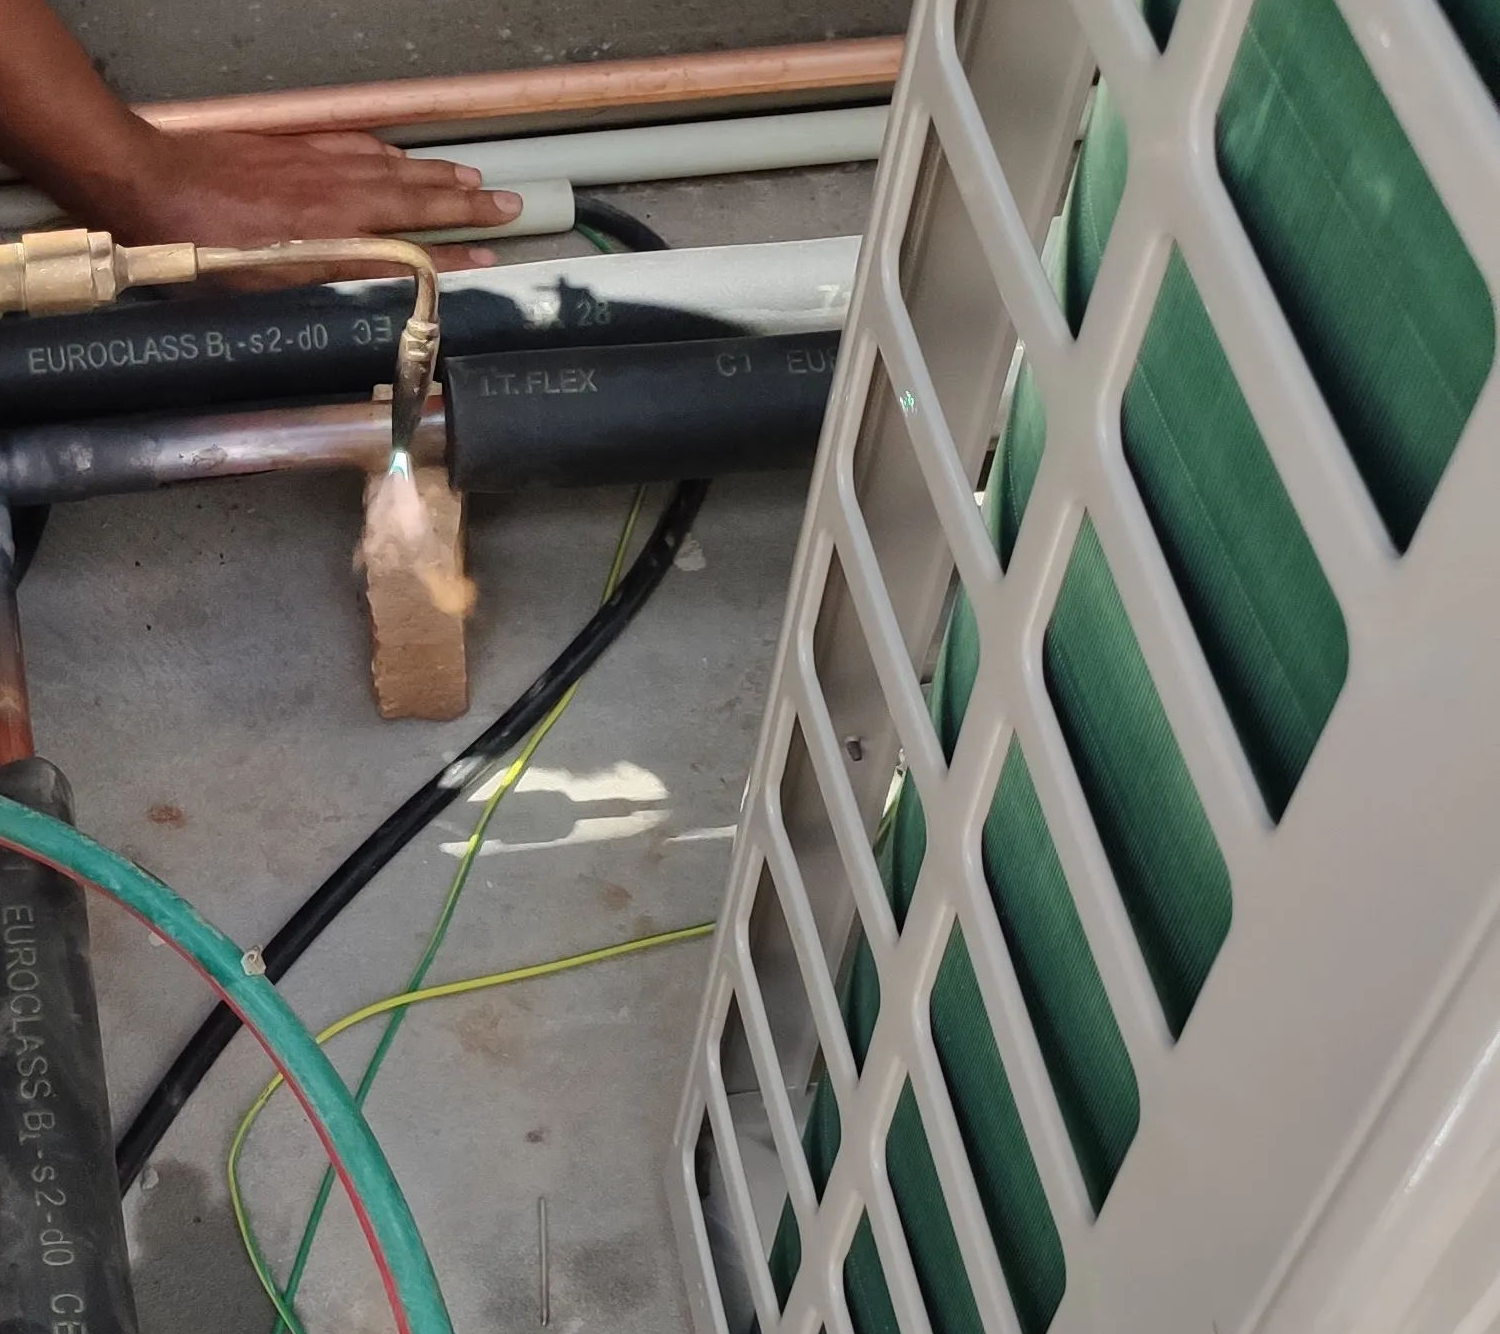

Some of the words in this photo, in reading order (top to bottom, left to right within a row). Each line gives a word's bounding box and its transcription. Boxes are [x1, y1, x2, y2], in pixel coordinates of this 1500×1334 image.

[27, 333, 199, 375] EUROCLASS
[576, 299, 612, 326] 28
[716, 351, 752, 377] C1
[2, 903, 51, 1100] EUROCLASS
